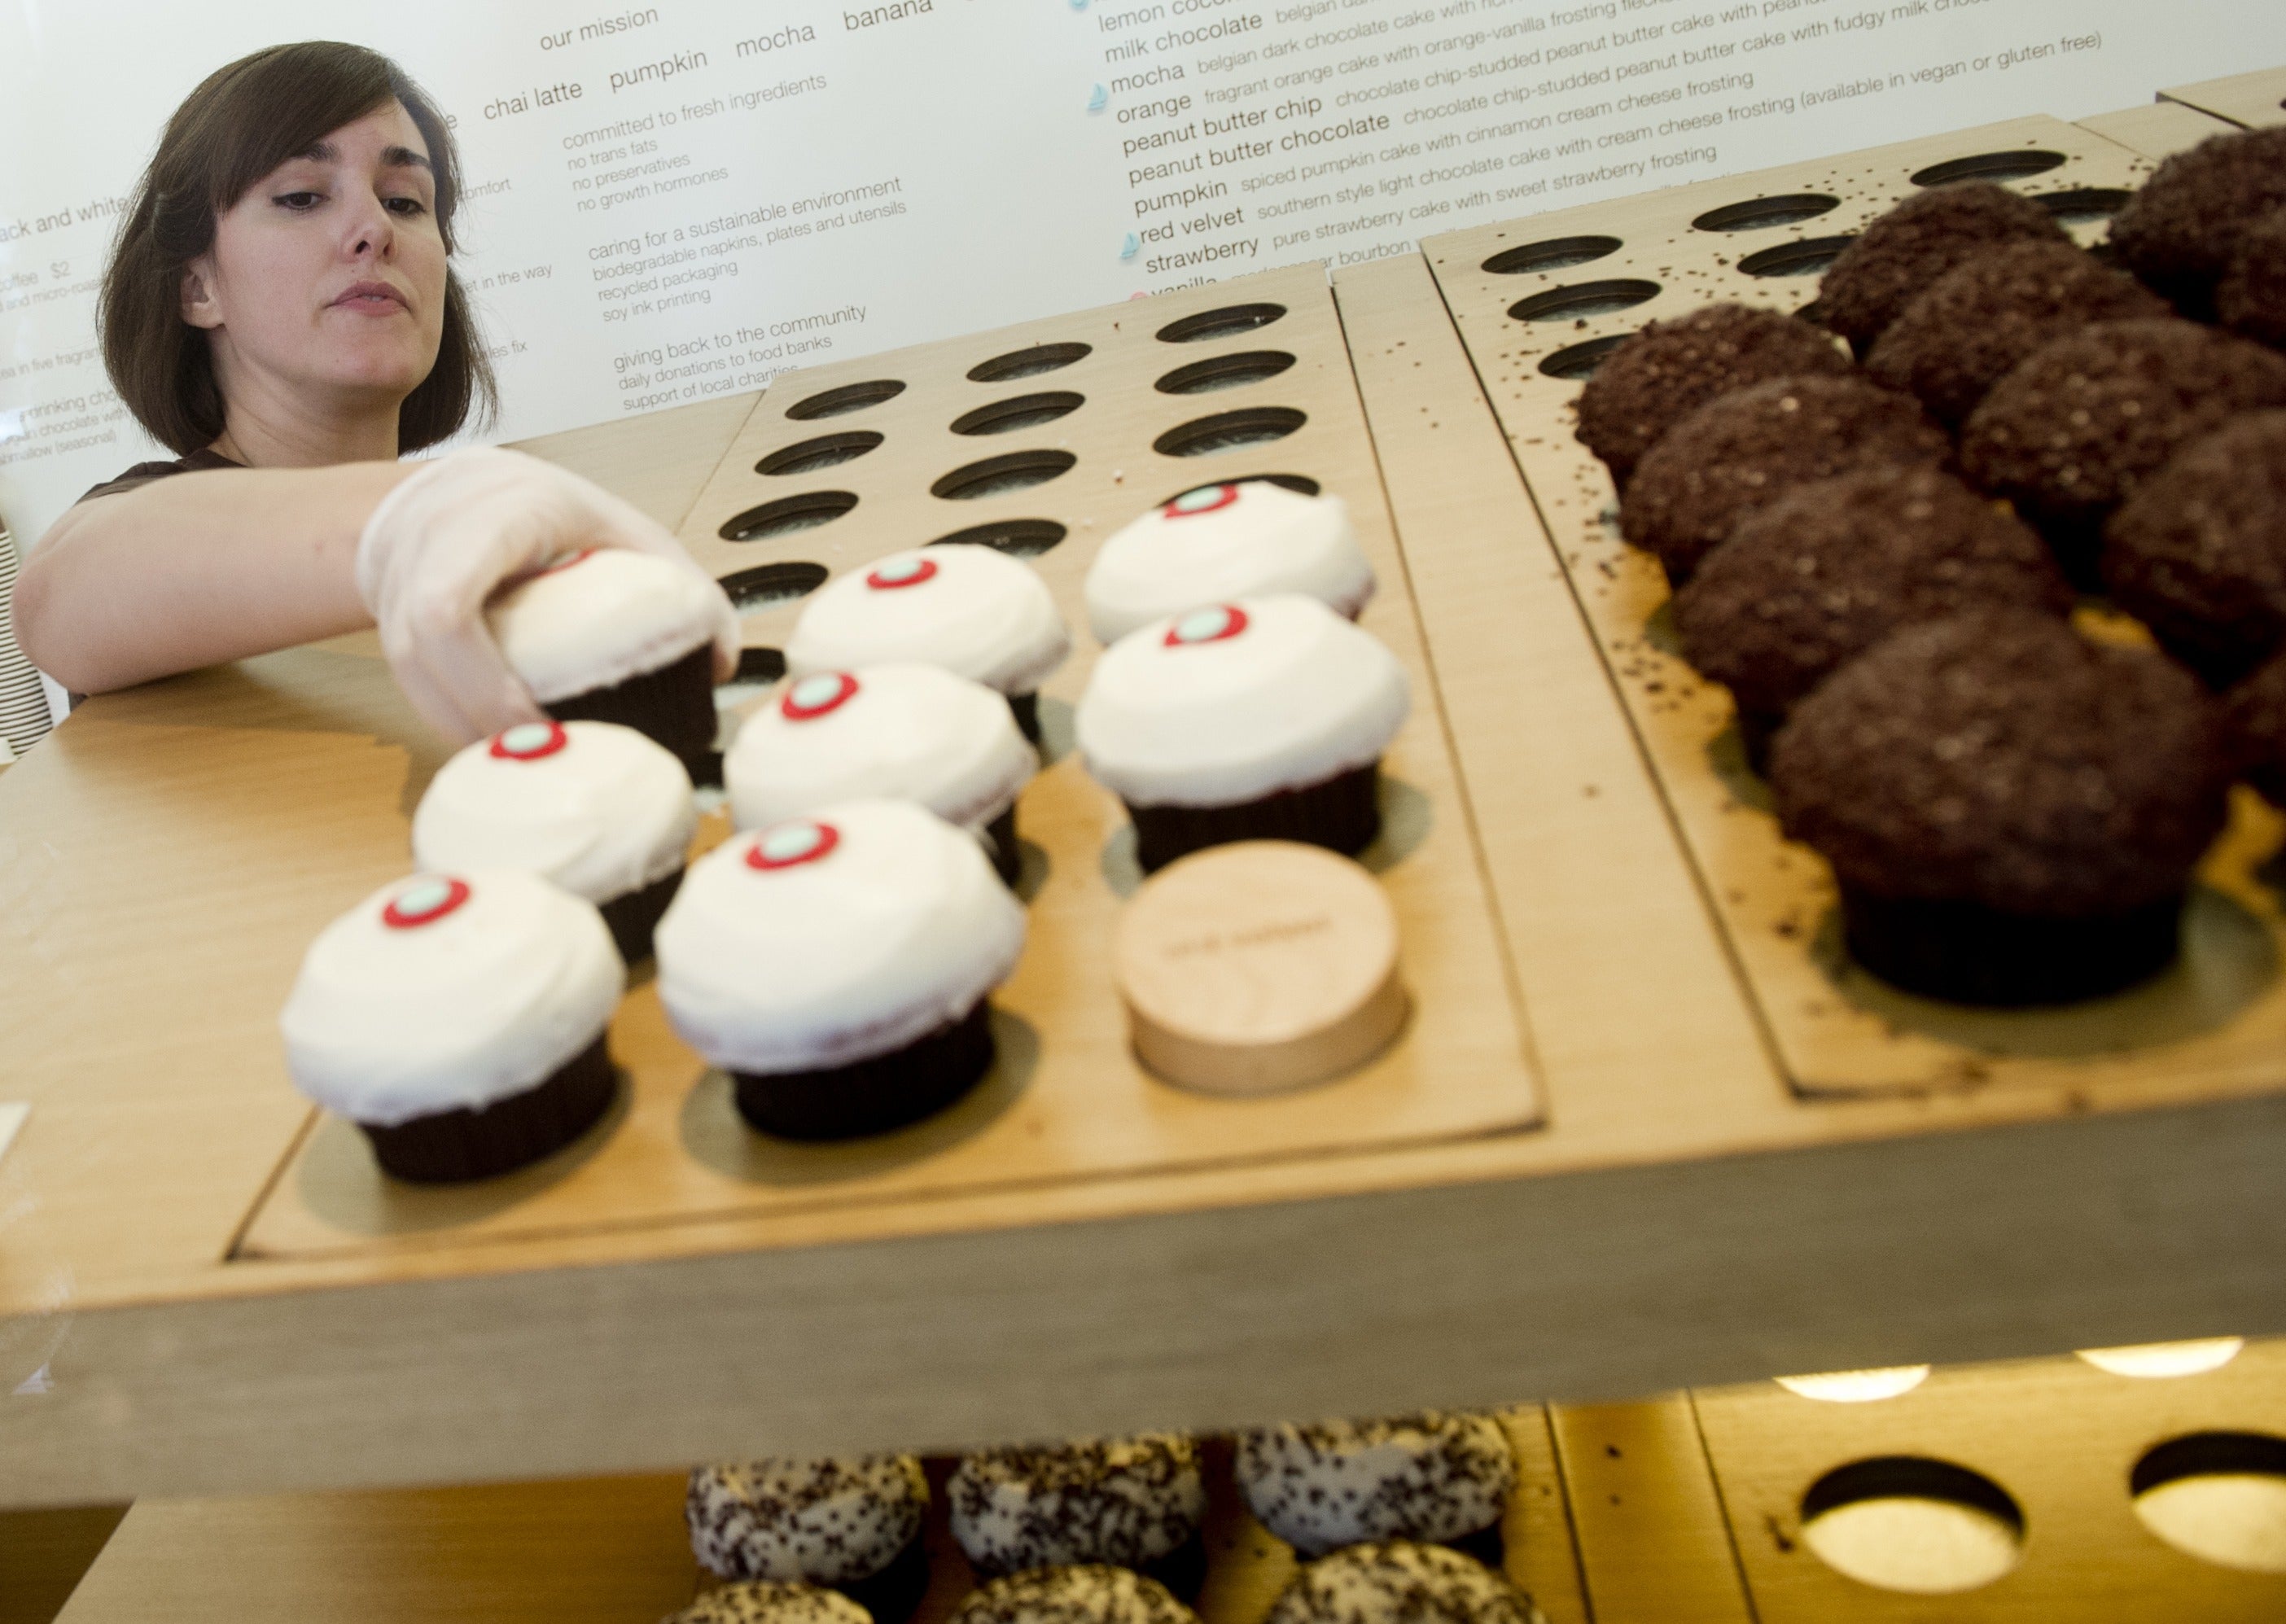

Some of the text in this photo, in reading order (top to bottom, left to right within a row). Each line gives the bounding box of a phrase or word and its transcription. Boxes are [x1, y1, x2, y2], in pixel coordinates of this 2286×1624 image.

[541, 9, 659, 50] our mission
[1098, 5, 1165, 33] lemon
[1106, 0, 1337, 63] milk chocolate belgian
[484, 0, 933, 120] chai latte pumpkin mocha banana
[1111, 65, 1185, 94] mocha
[1197, 50, 1257, 74] belgian
[1262, 39, 1300, 59] dark
[1304, 20, 1389, 50] chocolate
[1393, 10, 1435, 30] cake
[1440, 0, 1476, 19] with
[1117, 95, 1192, 123] orange
[1205, 77, 1269, 104] fragrant
[1274, 65, 1334, 89] orange
[1337, 55, 1379, 75] cake
[1384, 44, 1420, 63] with
[1424, 17, 1546, 55] orange-vanilla
[1550, 2, 1617, 26] frosting
[1123, 123, 1198, 157] peanut
[1203, 109, 1268, 135] butter
[1275, 96, 1322, 120] chip
[1335, 78, 1420, 107] chocolate
[1424, 48, 1541, 88] chip-studded
[1545, 35, 1607, 65] peanut
[1612, 24, 1666, 47] butter
[1671, 13, 1714, 34] cake
[1719, 3, 1757, 23] with
[1129, 153, 1203, 187] peanut
[1209, 140, 1273, 165] butter
[1281, 115, 1390, 149] chocolate
[1404, 96, 1488, 125] chocolate
[1493, 66, 1610, 105] chip-studded
[1615, 53, 1678, 82] peanut
[1683, 42, 1736, 65] butter
[1742, 33, 1785, 52] cake
[1790, 21, 1828, 42] with
[1833, 11, 1885, 32] fudgy
[1891, 0, 1929, 20] milk
[563, 76, 827, 150] committed to fresh ingredients
[1141, 31, 2102, 243] red velvet southern style light chocolate cake with cream cheese frosting (available in vegan or gluten free)
[567, 140, 658, 171] no trans fats
[1135, 72, 1754, 217] pumpkin spiced pumpkin cake with cinnamon cream cheese frosting
[461, 179, 511, 200] omfort
[572, 155, 690, 190] no preservatives
[577, 168, 729, 212] no growth hormones
[36, 207, 72, 234] and
[589, 177, 902, 260] caring for a sustainable environment
[1146, 238, 1258, 274] strawberry
[1273, 230, 1311, 251] pure
[1315, 210, 1404, 239] strawberry
[1409, 200, 1451, 220] cake
[1455, 190, 1491, 209] with
[1496, 178, 1548, 202] sweet
[1552, 161, 1645, 190] strawberry
[1650, 147, 1717, 169] frosting
[593, 201, 907, 281] biodegradable napkins, plates and utensils
[1338, 241, 1411, 265] bourbon
[50, 260, 71, 280] $2
[482, 276, 495, 290] in
[497, 270, 521, 287] the
[523, 265, 552, 280] way
[598, 261, 738, 301] recycled packaging
[602, 290, 711, 322] soy ink printing
[511, 339, 528, 354] fix
[614, 305, 865, 374] giving back to the community
[619, 336, 832, 390] daily donations to food banks
[624, 387, 679, 410] support
[683, 383, 696, 398] of
[700, 375, 734, 394] local
